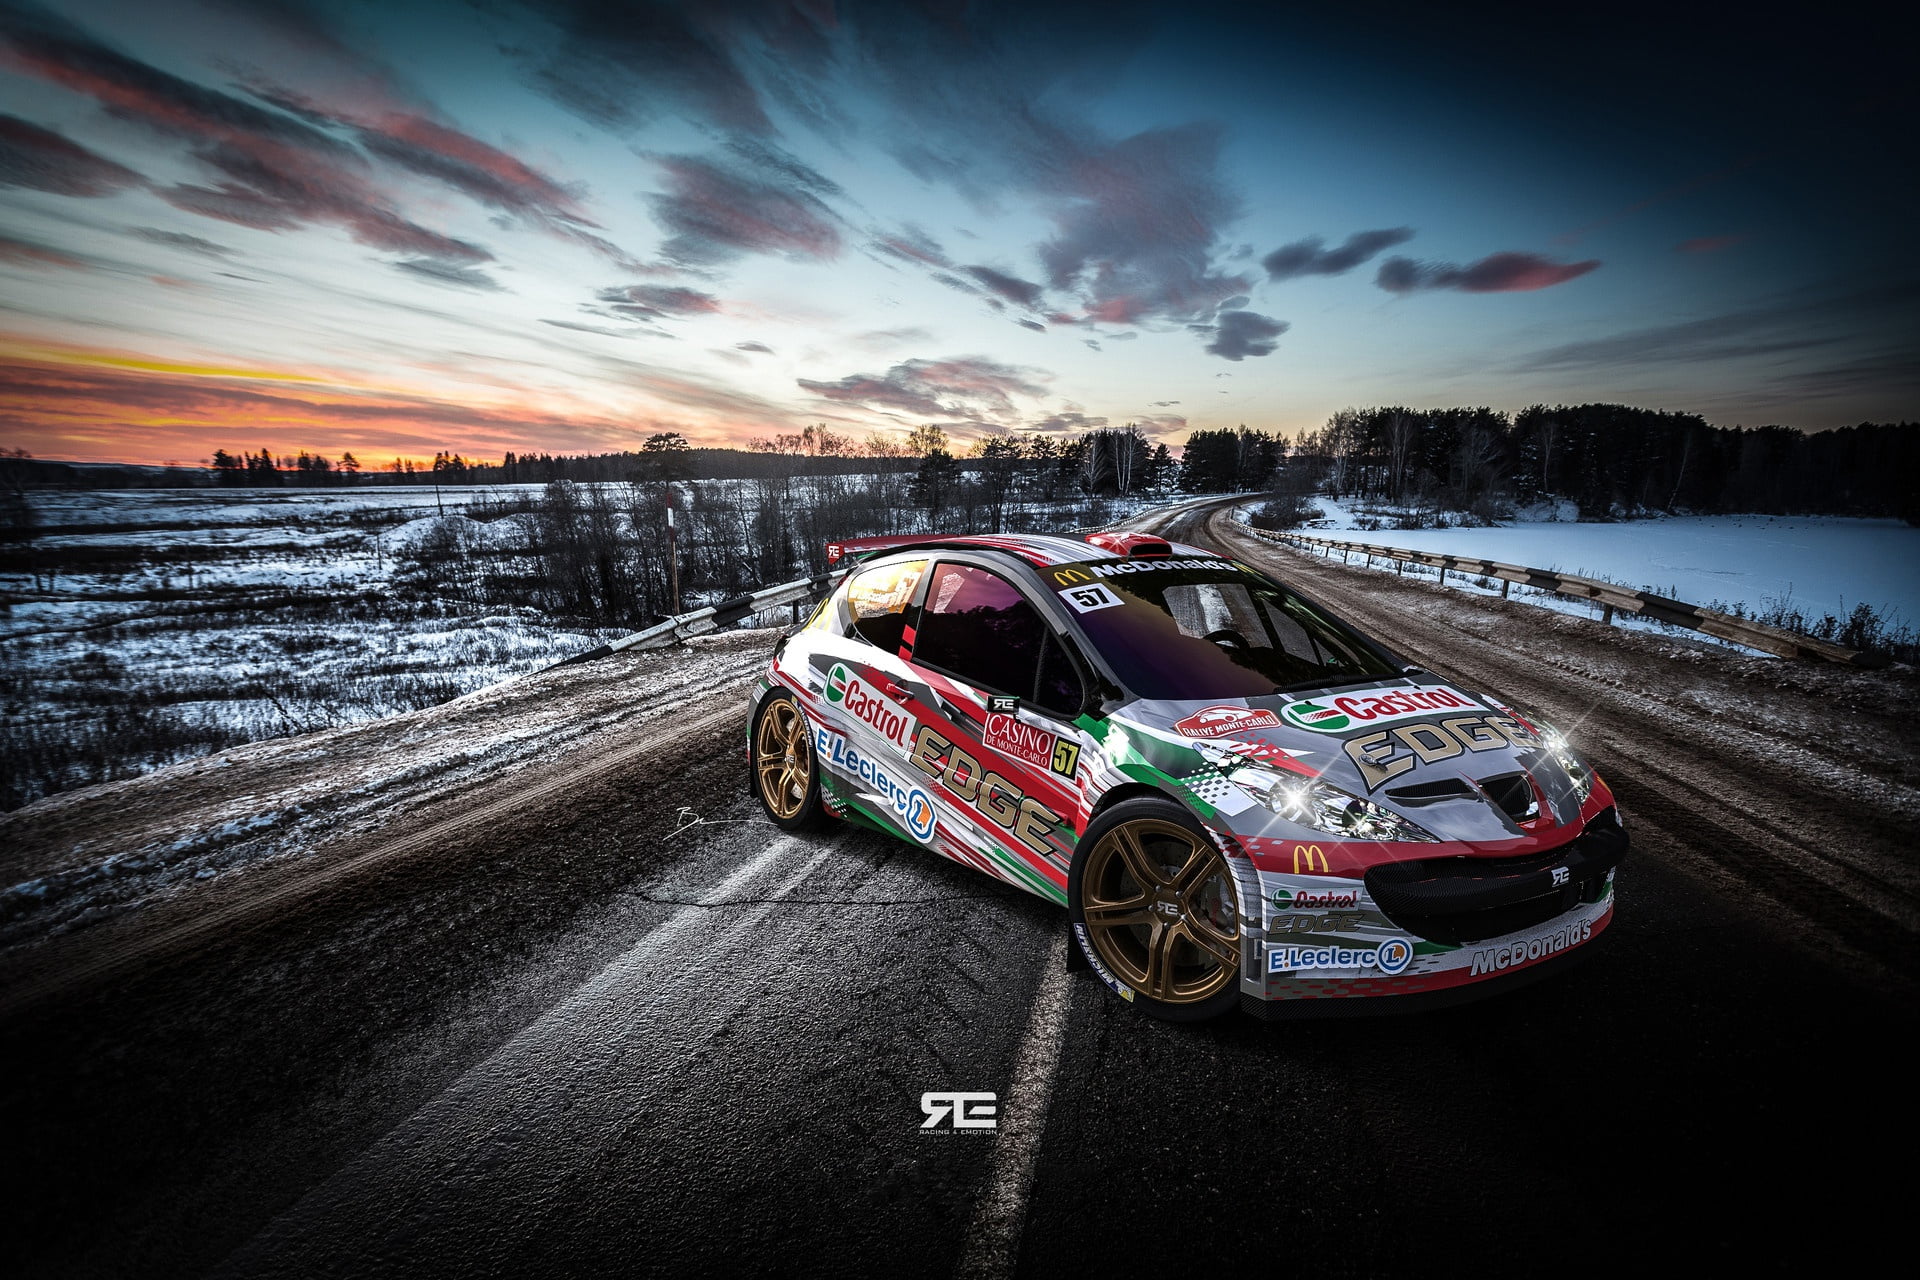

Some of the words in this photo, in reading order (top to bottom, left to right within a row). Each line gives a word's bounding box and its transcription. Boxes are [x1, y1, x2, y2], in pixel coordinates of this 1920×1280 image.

[1090, 558, 1239, 578] McDonald's
[1070, 586, 1110, 608] 57
[844, 680, 908, 747] Castrol
[1334, 688, 1476, 720] Castrol
[989, 714, 1051, 755] CASINO
[1182, 726, 1215, 737] RALLYE
[1215, 715, 1276, 734] MONTE-CARLO
[986, 734, 996, 746] DE
[997, 741, 1048, 767] MONTE-CARLO
[1053, 740, 1079, 776] 57
[1342, 715, 1544, 795] EDGE
[816, 727, 908, 811] E.Leclerc
[910, 725, 1060, 856] EDGE
[1293, 890, 1358, 909] Castrol
[1268, 914, 1366, 935] EDGE
[1271, 948, 1376, 970] E.Leclerc
[1470, 918, 1592, 977] McDonald's
